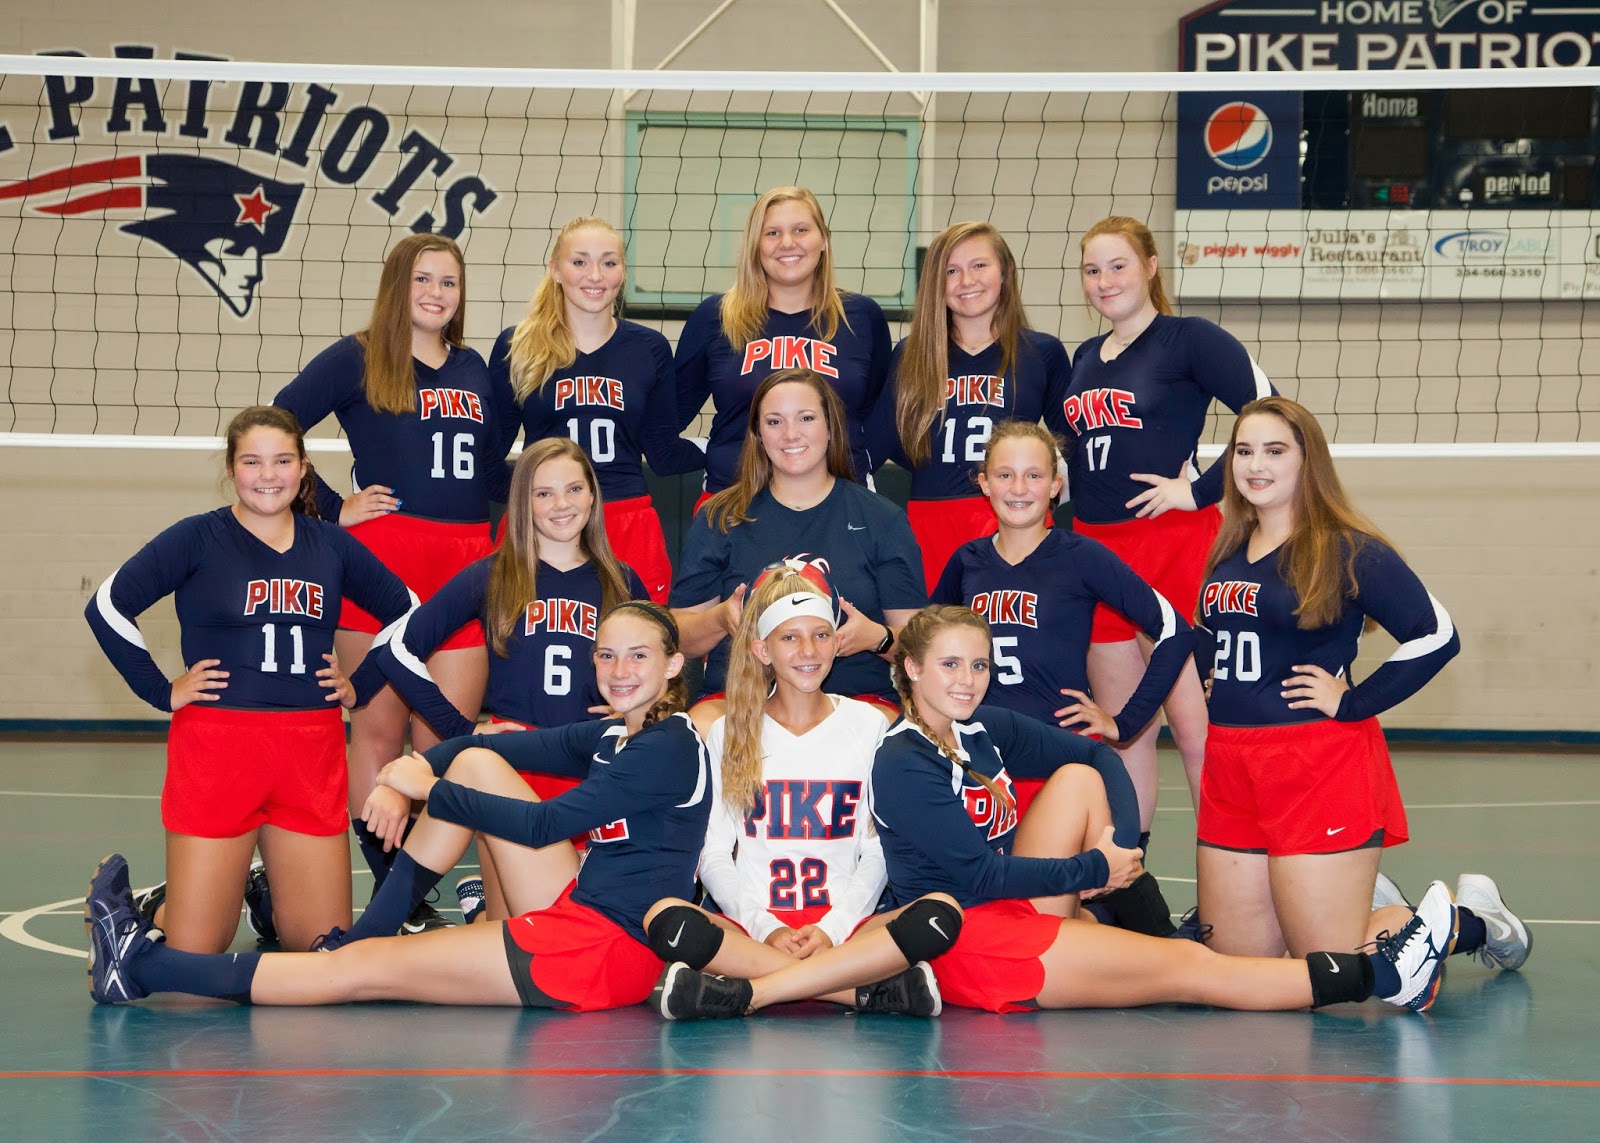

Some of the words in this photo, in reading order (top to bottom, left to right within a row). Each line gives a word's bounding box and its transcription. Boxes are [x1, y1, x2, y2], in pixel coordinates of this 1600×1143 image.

[1320, 1, 1423, 24] HOME
[1477, 0, 1528, 24] OF
[1195, 33, 1339, 72] PIKE
[1357, 31, 1600, 71] PATRIO
[1362, 93, 1419, 118] Home
[37, 45, 498, 240] PATRIOTS
[1206, 173, 1269, 195] pepsi
[1484, 171, 1551, 200] period
[1203, 243, 1247, 258] piggly
[1253, 243, 1301, 258] wiggly
[1309, 229, 1377, 245] Julia's
[1309, 246, 1423, 262] Restaurant
[1457, 238, 1502, 252] TROY
[740, 335, 840, 379] PIKE
[420, 388, 484, 424] PIKE
[555, 376, 625, 411] PIKE
[1063, 388, 1143, 437] PIKE
[431, 432, 475, 480] 16
[566, 418, 616, 463] 10
[942, 416, 993, 463] 12
[1086, 435, 1112, 471] 17
[244, 579, 325, 620] PIKE
[525, 598, 598, 641] PIKE
[971, 590, 1038, 629] PIKE
[1203, 581, 1261, 617] PIKE
[261, 623, 306, 674] 11
[992, 636, 1024, 685] 5
[1213, 630, 1262, 682] 20
[543, 644, 572, 696] 6
[769, 857, 832, 909] 22
